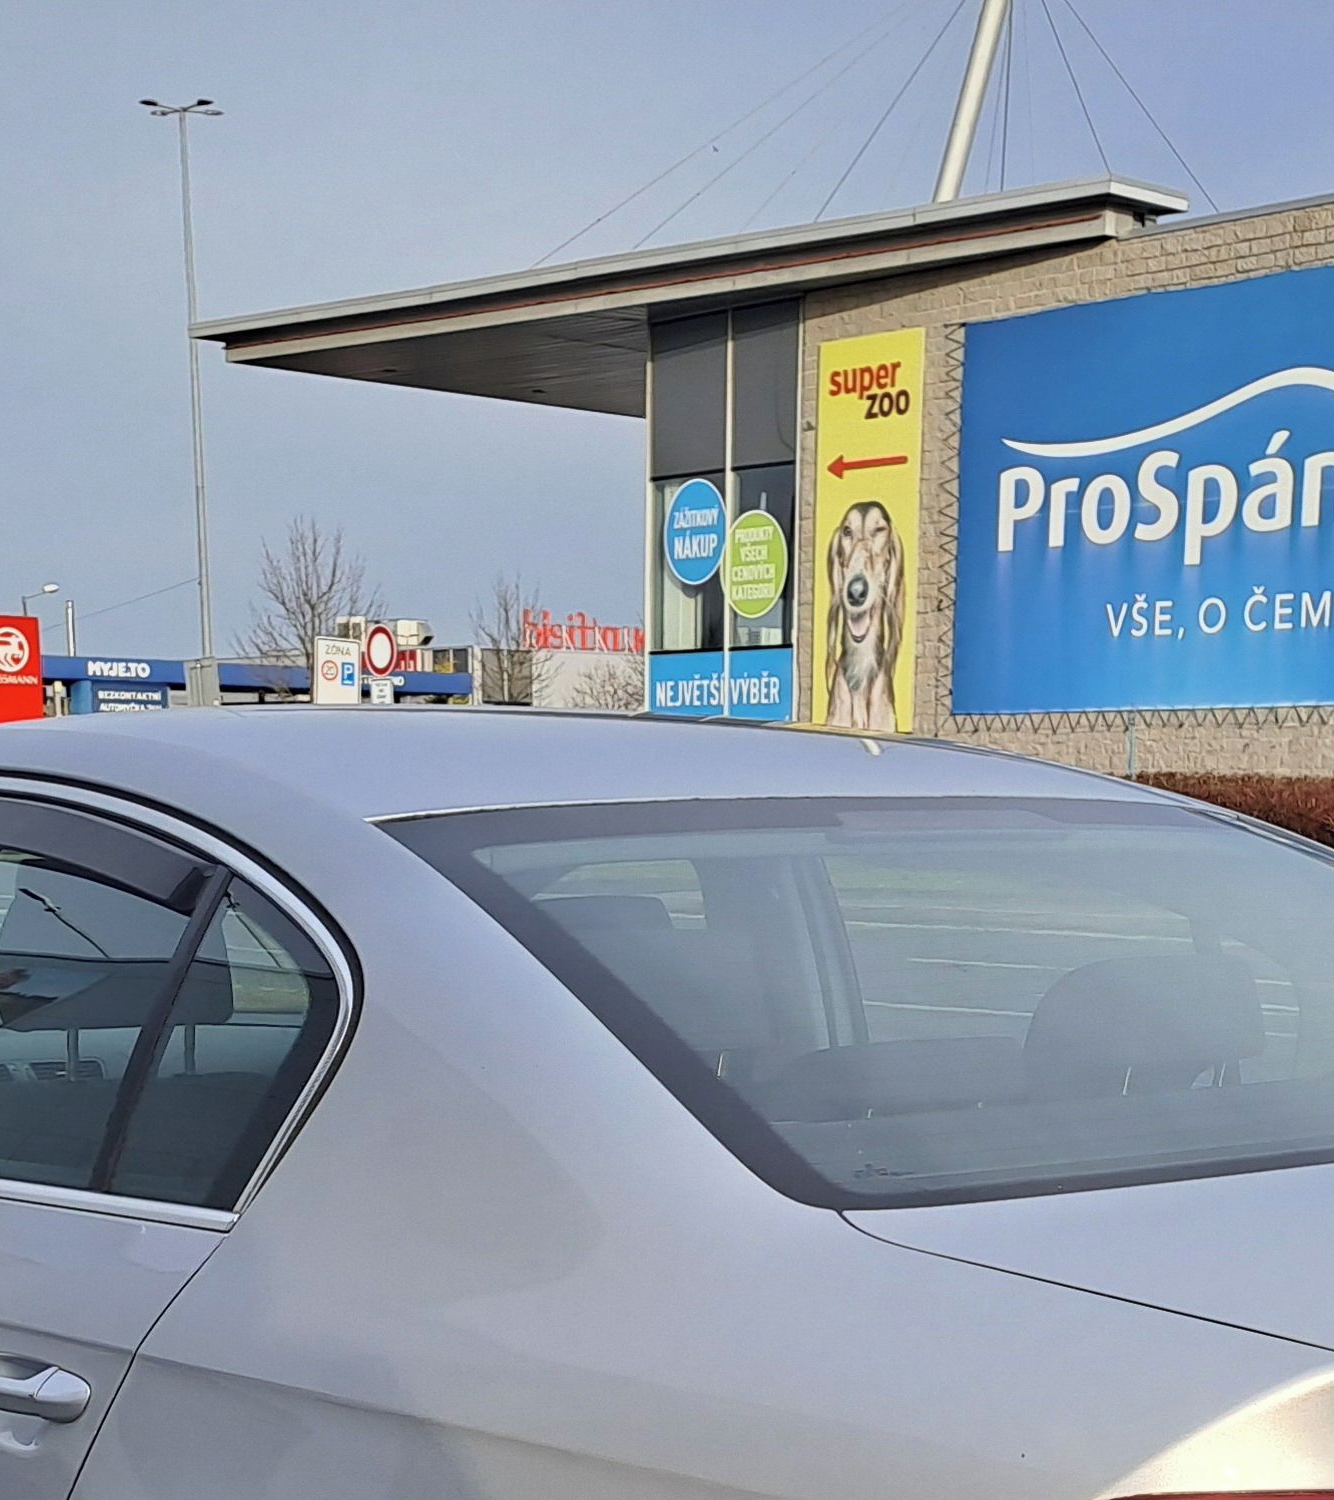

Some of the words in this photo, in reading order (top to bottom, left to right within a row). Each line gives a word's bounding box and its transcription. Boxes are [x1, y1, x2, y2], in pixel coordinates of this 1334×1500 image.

[829, 361, 902, 401] super
[864, 389, 910, 420] zoo
[673, 531, 718, 560] NÁKUP
[1105, 592, 1185, 640] VŠE,
[1198, 598, 1226, 634] O
[1244, 586, 1331, 632] ČEM
[655, 673, 724, 709] NEJVĚTŠÍ
[729, 670, 780, 705] VÝBĚR
